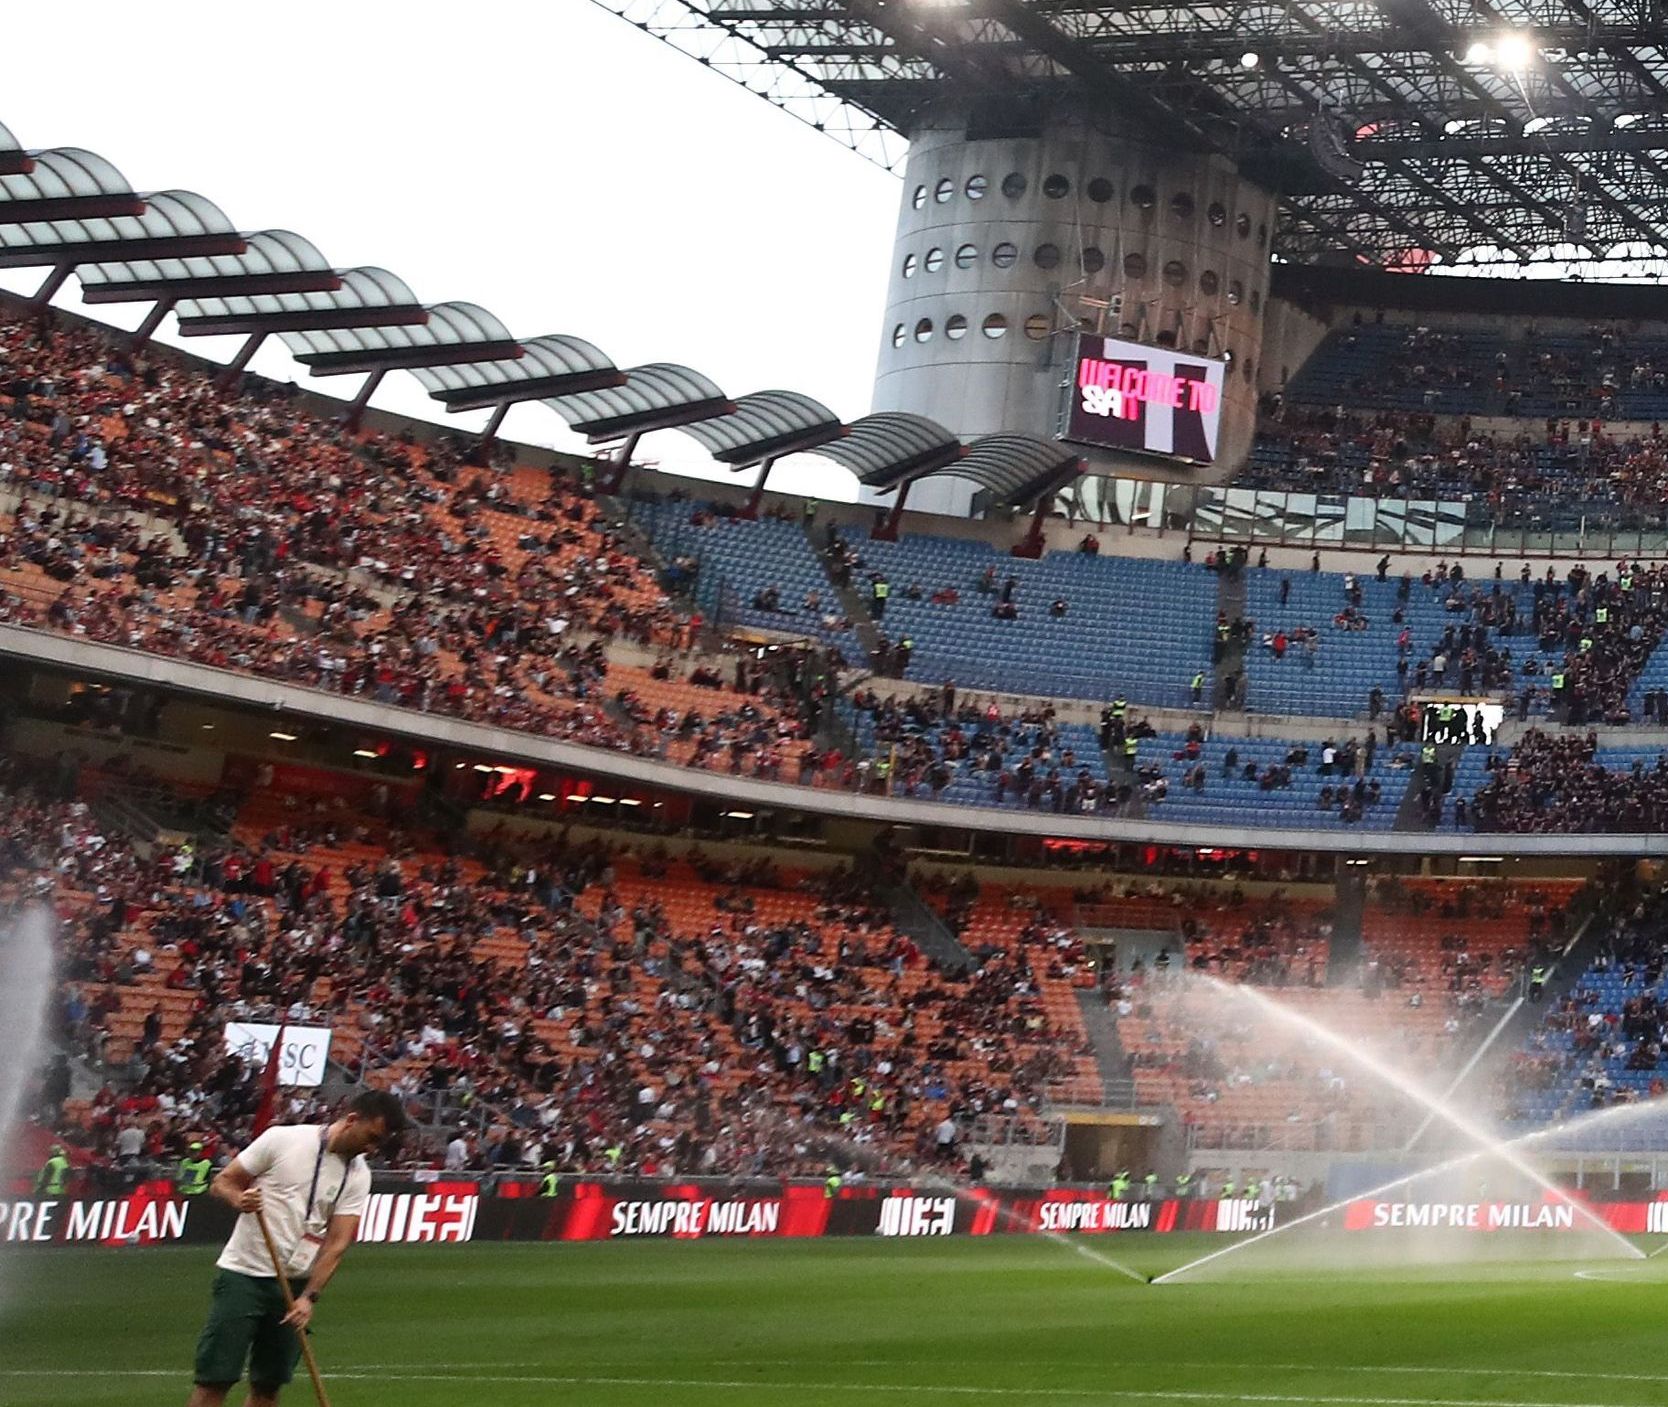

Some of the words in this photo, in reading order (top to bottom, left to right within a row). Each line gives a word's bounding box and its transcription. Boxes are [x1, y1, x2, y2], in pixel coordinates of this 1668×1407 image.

[1188, 380, 1217, 415] TO
[66, 1200, 190, 1239] MILAN
[610, 1201, 704, 1234] SEMPRE
[707, 1201, 780, 1232] MILAN
[1039, 1202, 1101, 1230] SEMPRE
[1102, 1203, 1150, 1229] MILAN
[1374, 1203, 1480, 1226] SEMPRE
[1488, 1204, 1573, 1227] MILAN
